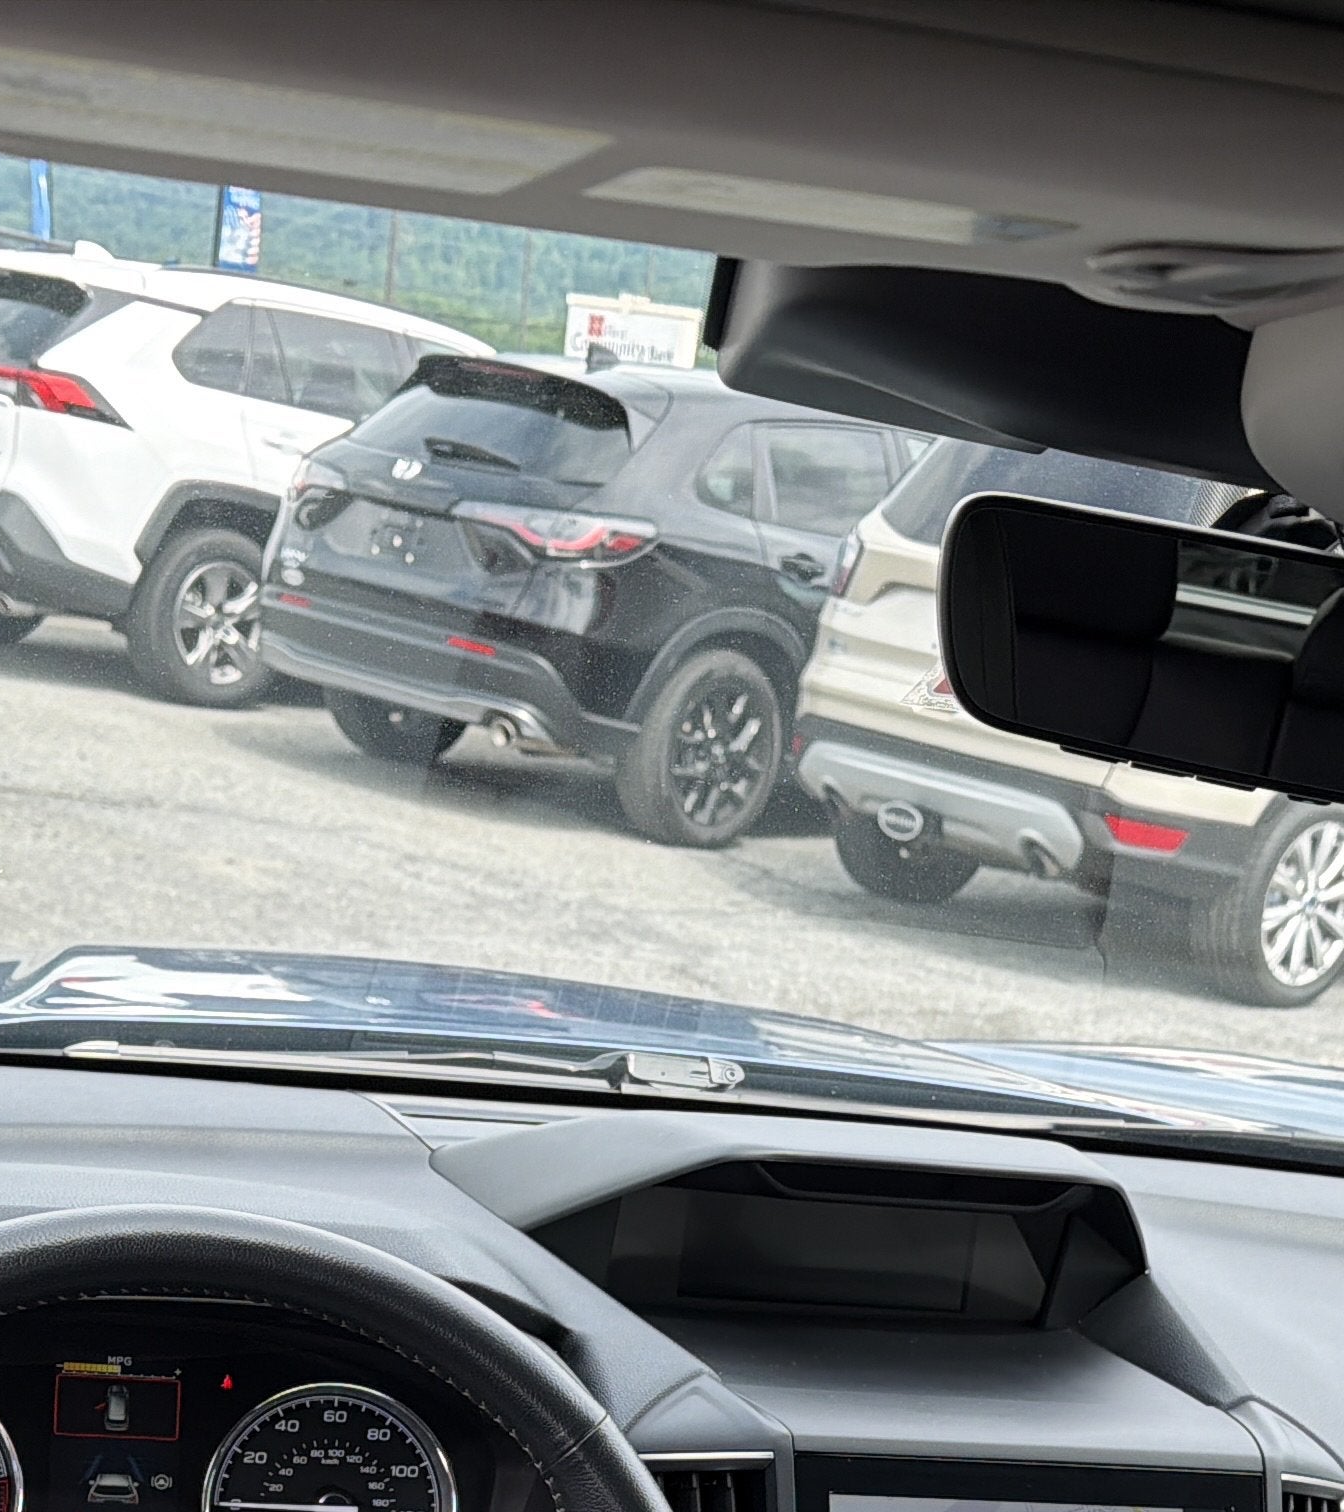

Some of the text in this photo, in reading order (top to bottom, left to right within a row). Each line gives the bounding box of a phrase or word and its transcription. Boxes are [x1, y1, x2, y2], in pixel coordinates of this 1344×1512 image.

[107, 1356, 133, 1366] MPG
[323, 1410, 347, 1423] 60
[274, 1419, 299, 1433] 40
[366, 1428, 391, 1441] 80
[243, 1451, 267, 1464] 20
[310, 1449, 324, 1458] 80
[327, 1449, 345, 1458] 100
[293, 1456, 307, 1464] 60
[346, 1454, 363, 1463] 120
[278, 1468, 293, 1476] 40
[359, 1466, 377, 1474] 140
[390, 1465, 419, 1478] 100
[268, 1483, 283, 1492] 20
[368, 1482, 384, 1490] 160
